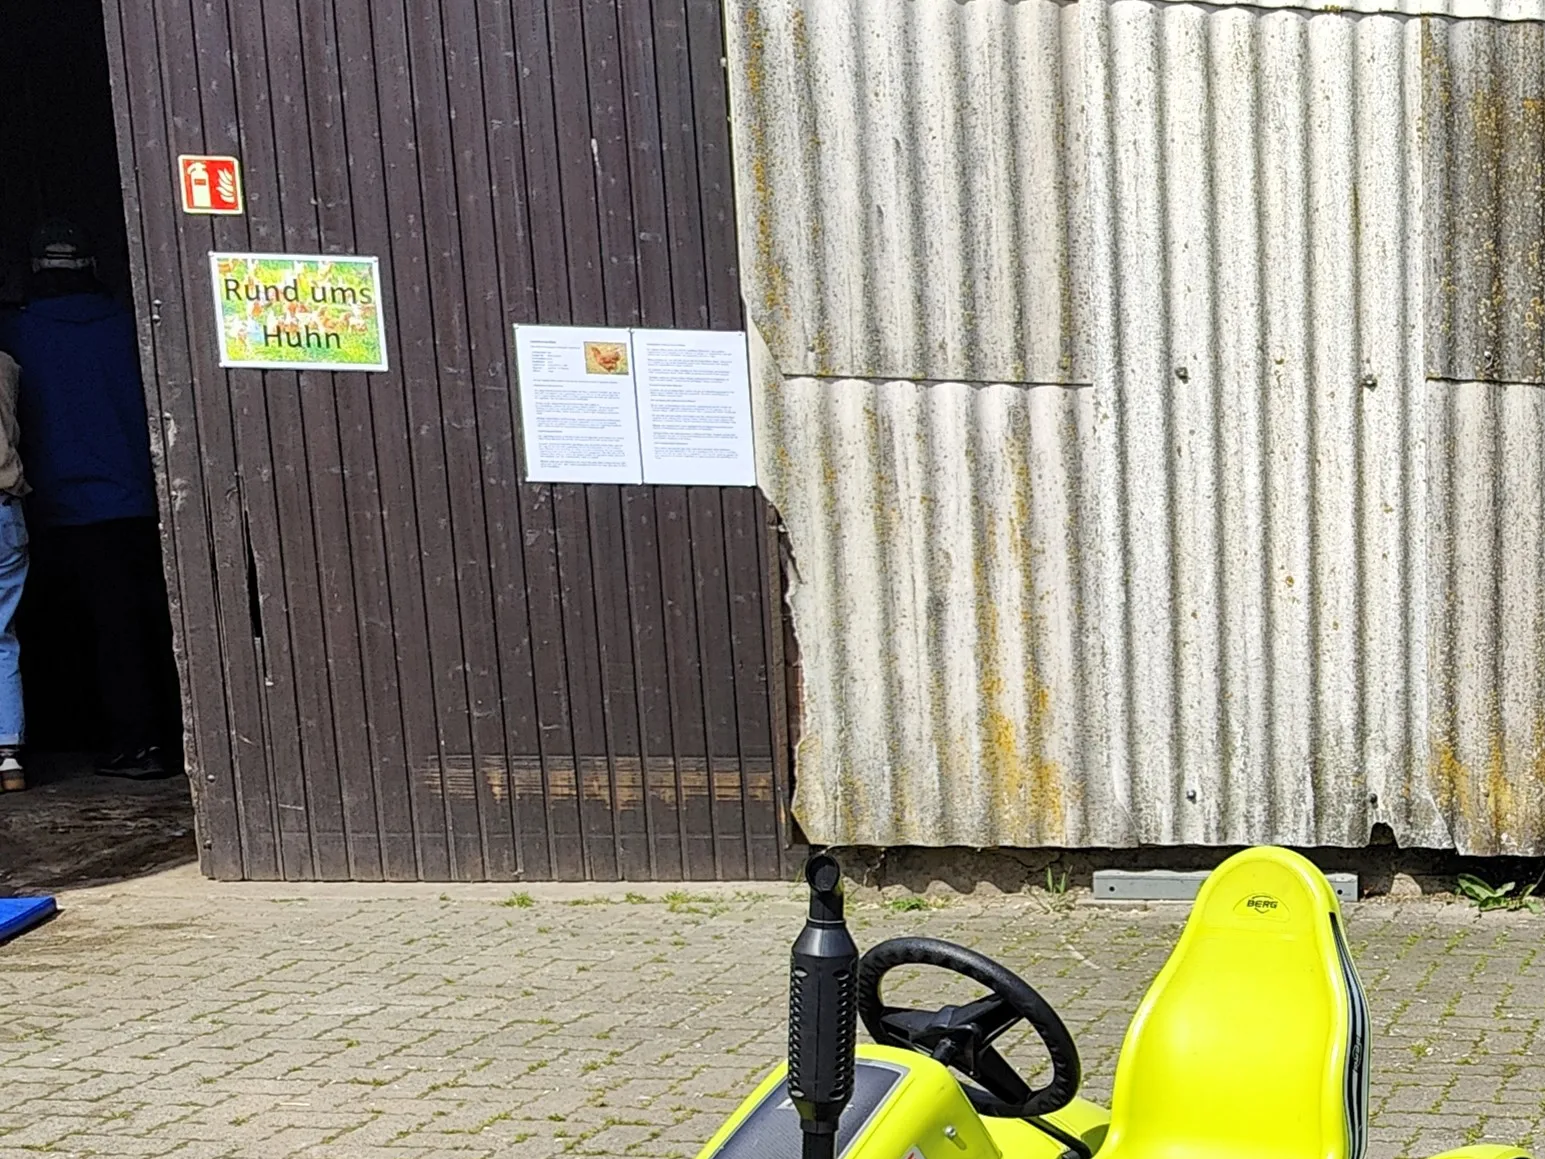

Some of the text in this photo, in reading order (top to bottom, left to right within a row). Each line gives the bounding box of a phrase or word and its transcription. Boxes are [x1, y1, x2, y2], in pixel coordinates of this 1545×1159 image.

[224, 277, 373, 305] Rund ums
[263, 324, 341, 350] Huhn
[1246, 898, 1279, 910] BERG
